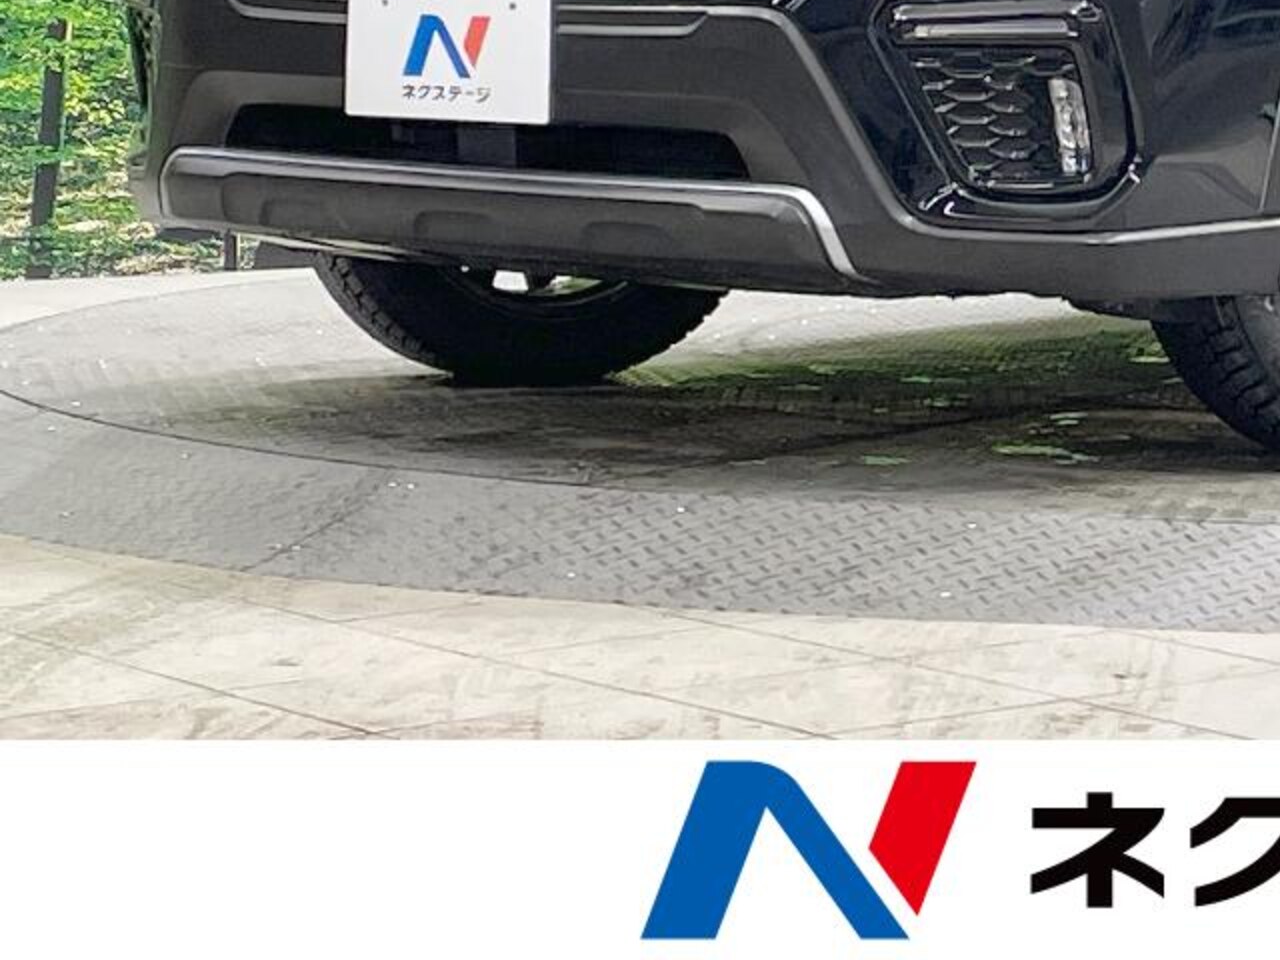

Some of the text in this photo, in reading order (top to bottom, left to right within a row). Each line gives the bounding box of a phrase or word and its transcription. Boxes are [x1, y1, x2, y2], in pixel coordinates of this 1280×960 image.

[402, 84, 491, 103] ネクステージ
